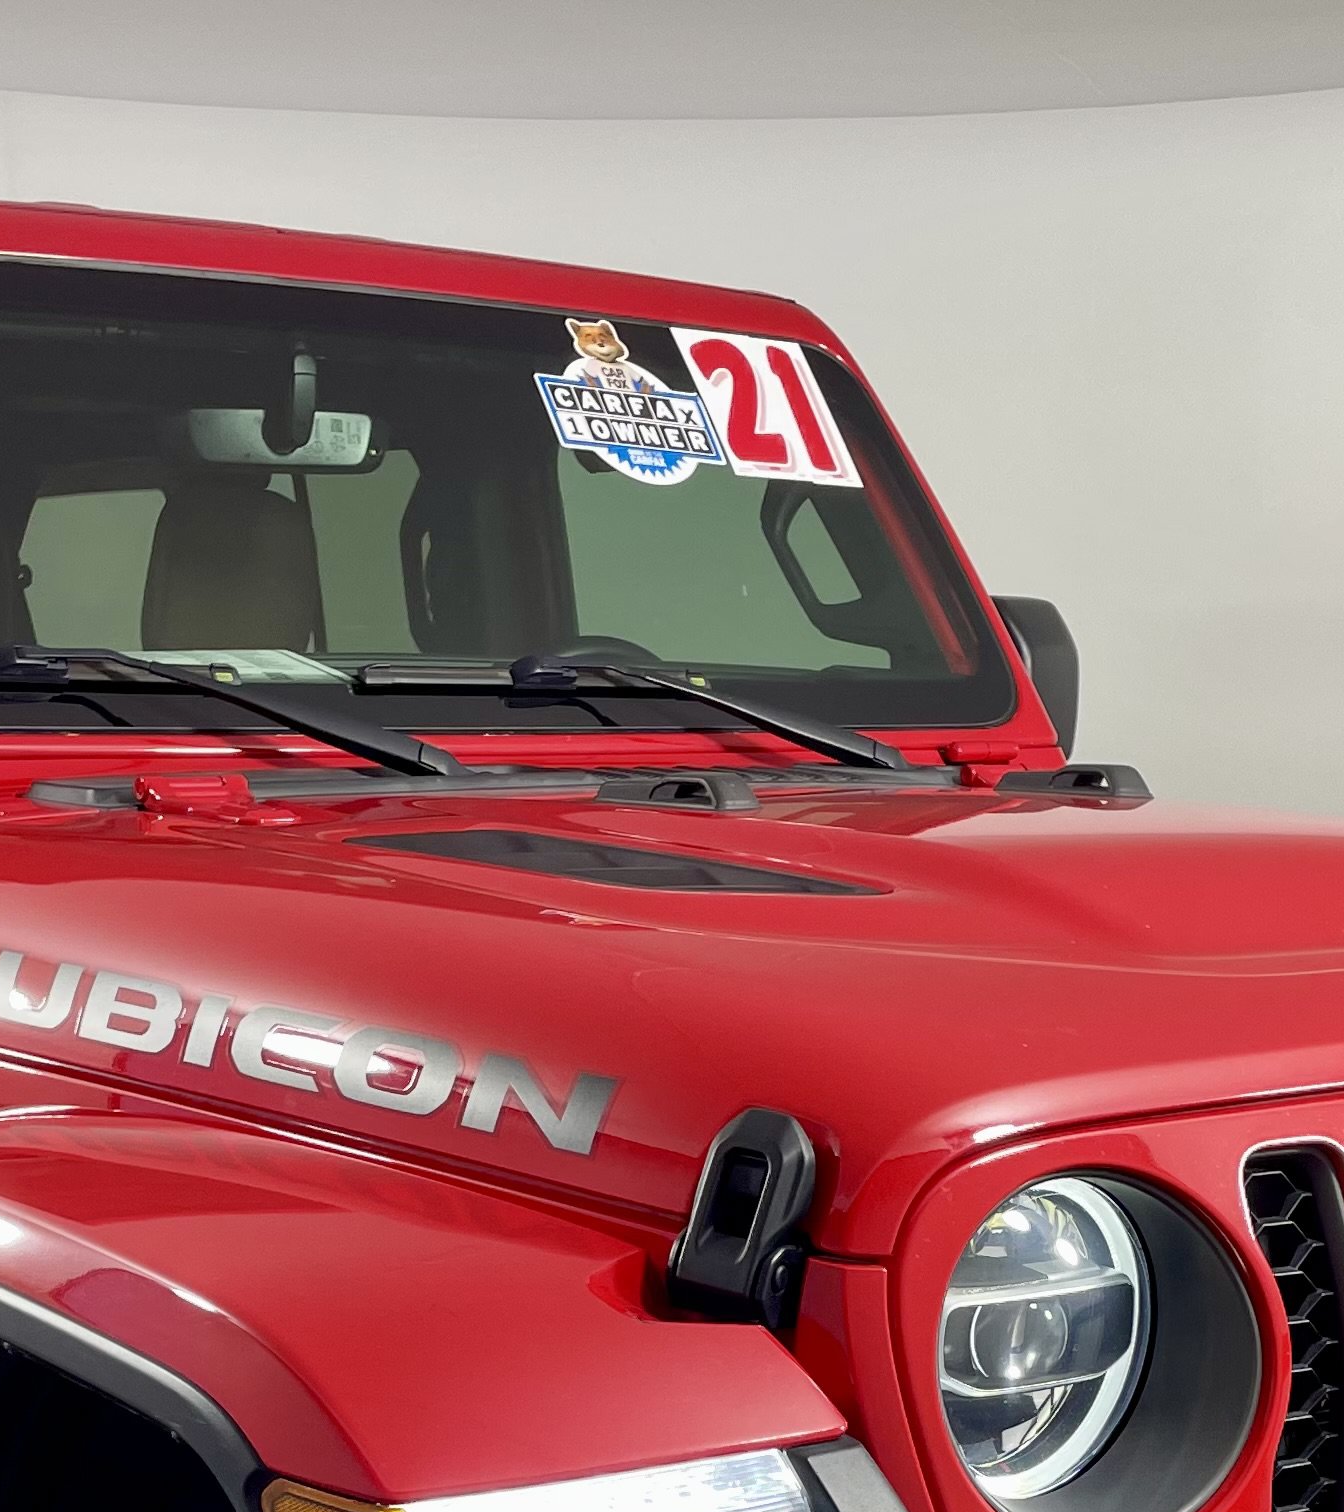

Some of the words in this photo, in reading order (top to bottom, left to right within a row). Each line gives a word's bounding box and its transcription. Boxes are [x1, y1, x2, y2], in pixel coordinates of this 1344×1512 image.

[601, 366, 626, 378] CAR
[606, 378, 630, 389] FOX
[554, 387, 698, 425] CARFAX
[690, 338, 837, 472] 21
[567, 417, 583, 436] 1
[589, 419, 710, 451] OWNER
